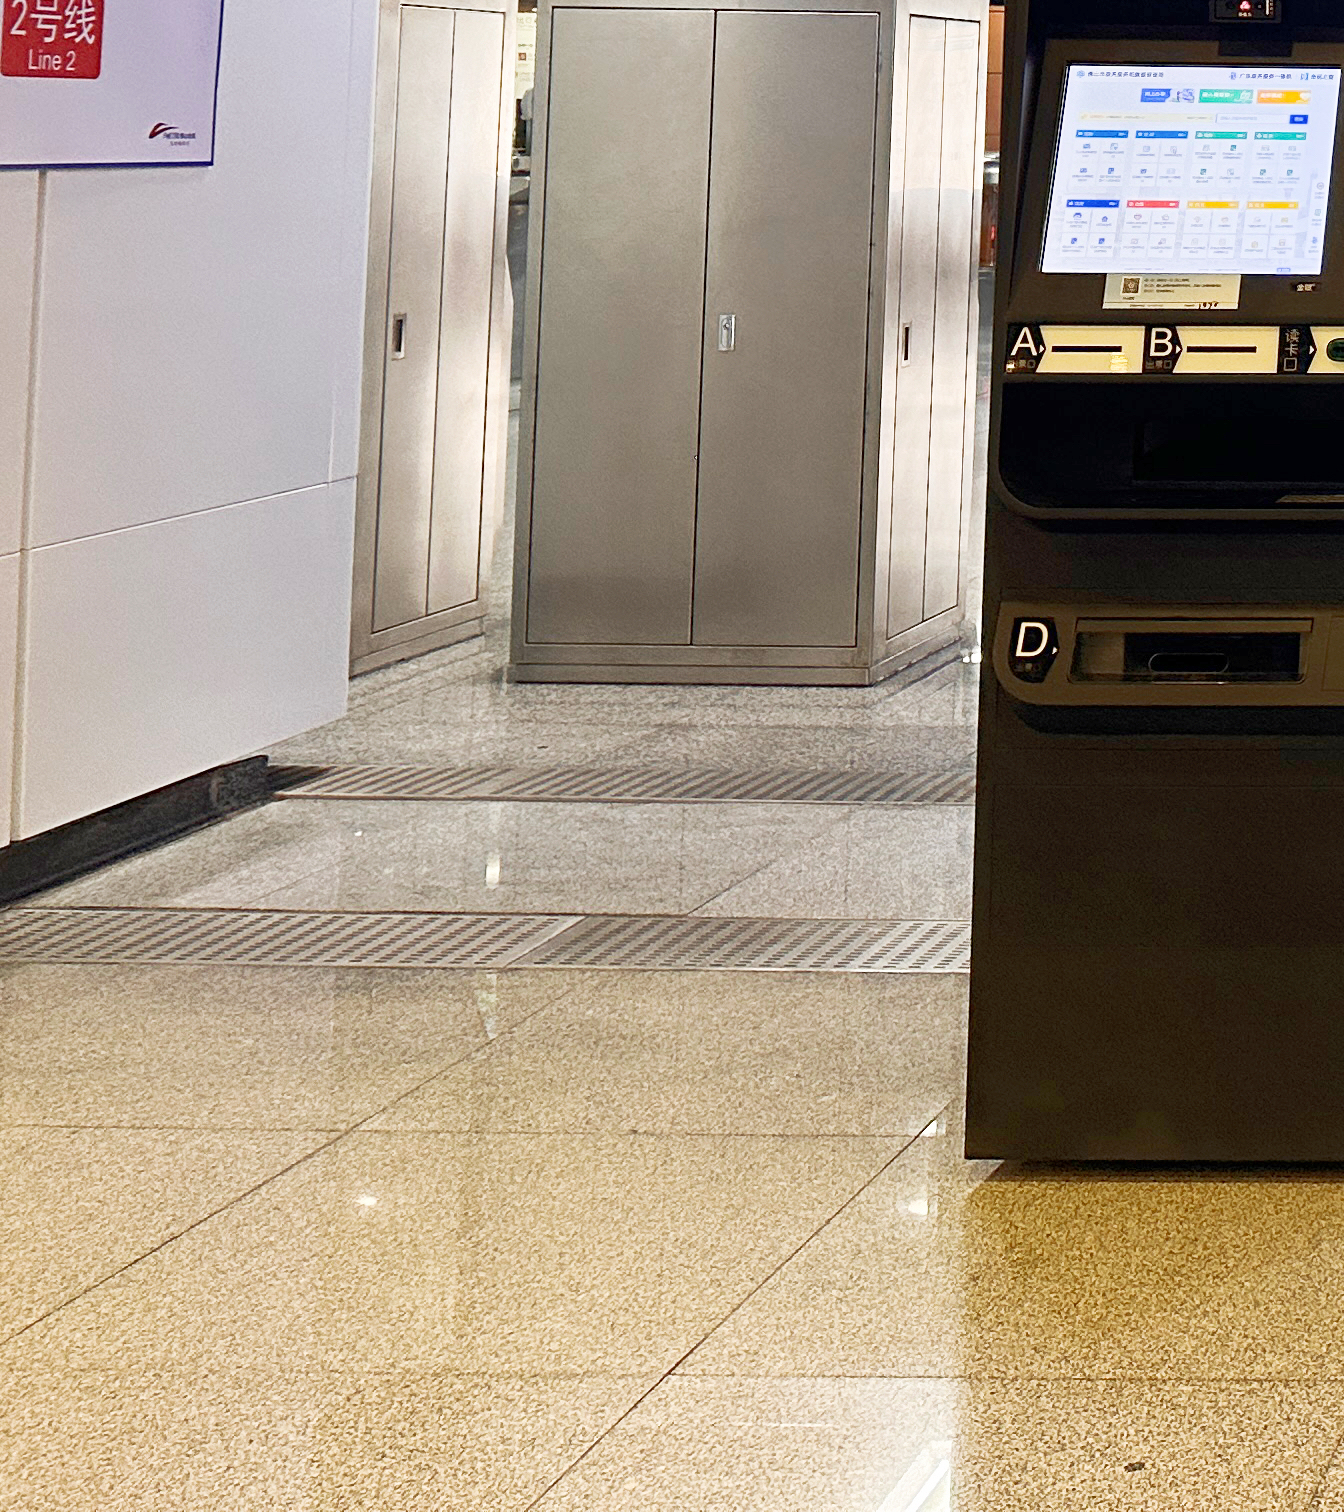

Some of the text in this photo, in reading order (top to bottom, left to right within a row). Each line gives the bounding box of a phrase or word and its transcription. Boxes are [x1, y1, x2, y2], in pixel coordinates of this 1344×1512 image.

[27, 48, 77, 71] Line 2
[1010, 326, 1038, 357] A
[1149, 326, 1174, 357] B
[1015, 621, 1049, 657] D
